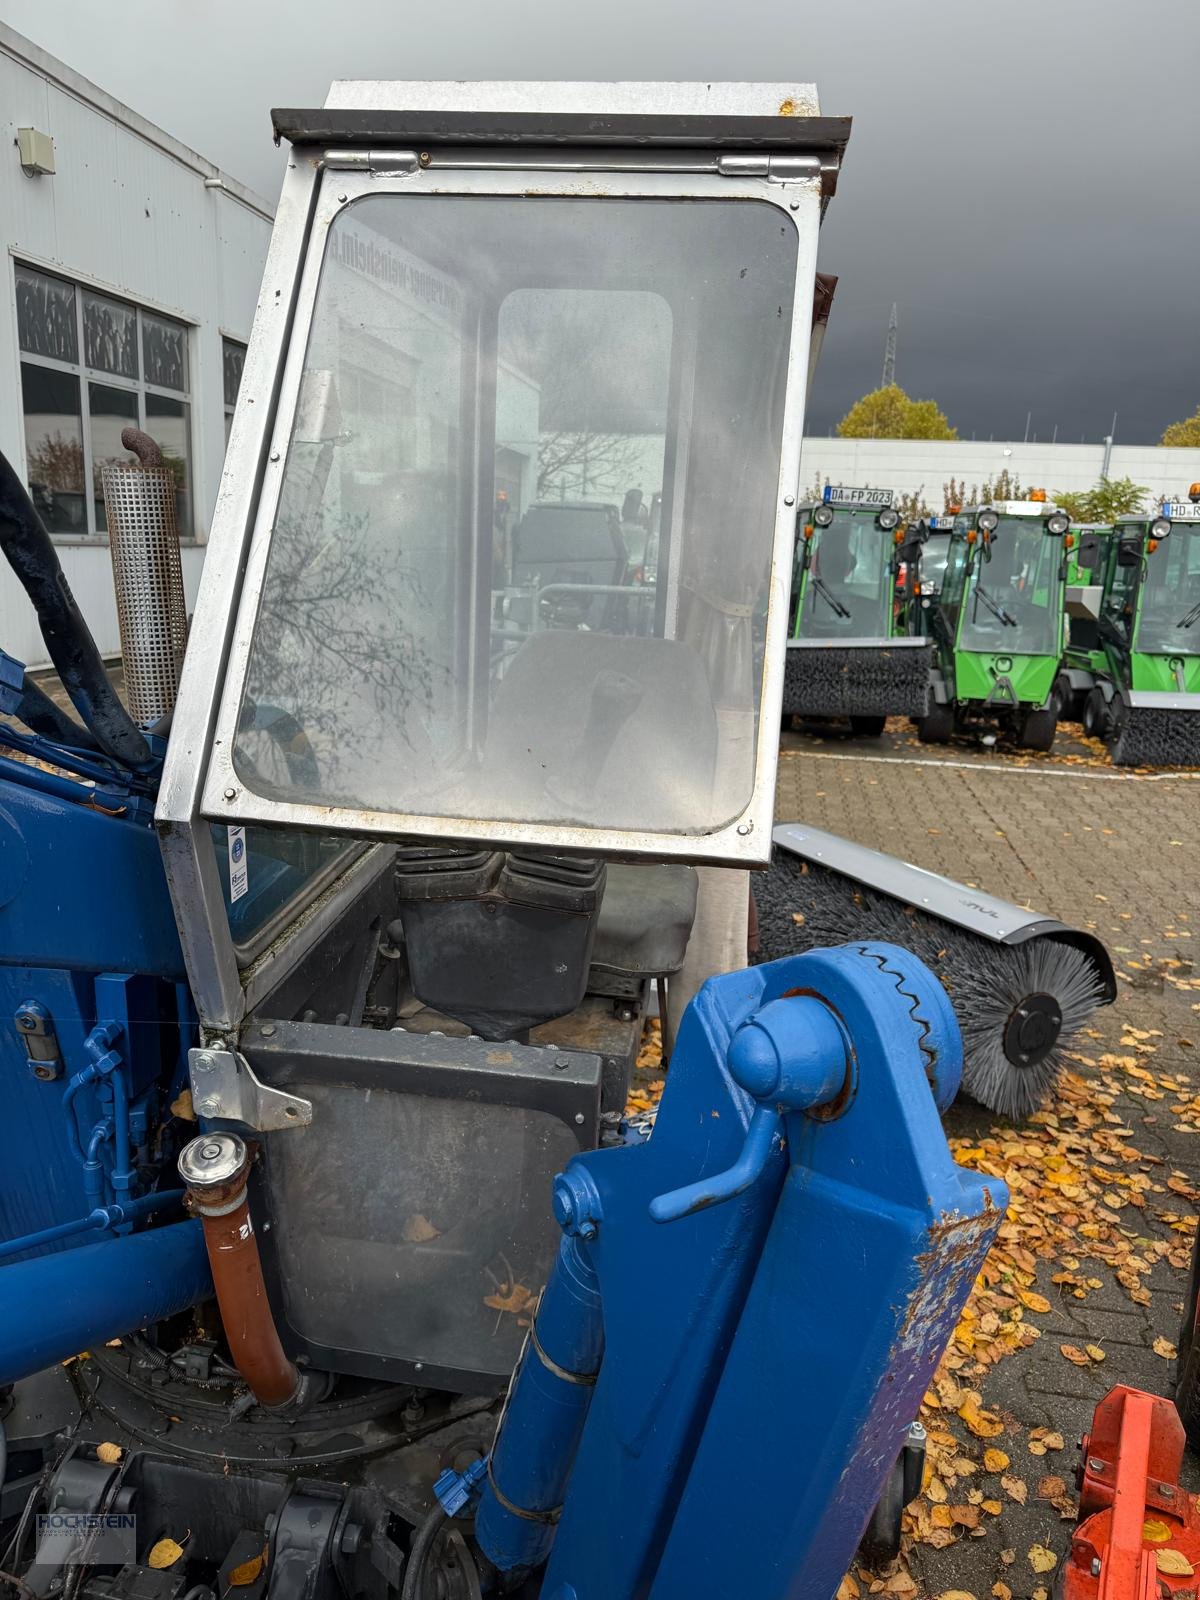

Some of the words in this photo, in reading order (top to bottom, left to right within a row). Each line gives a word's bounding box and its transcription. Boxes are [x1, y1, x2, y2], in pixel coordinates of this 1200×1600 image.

[832, 489, 843, 500] DA
[851, 491, 864, 502] FP
[866, 492, 891, 504] 2023
[1171, 506, 1185, 516] HD
